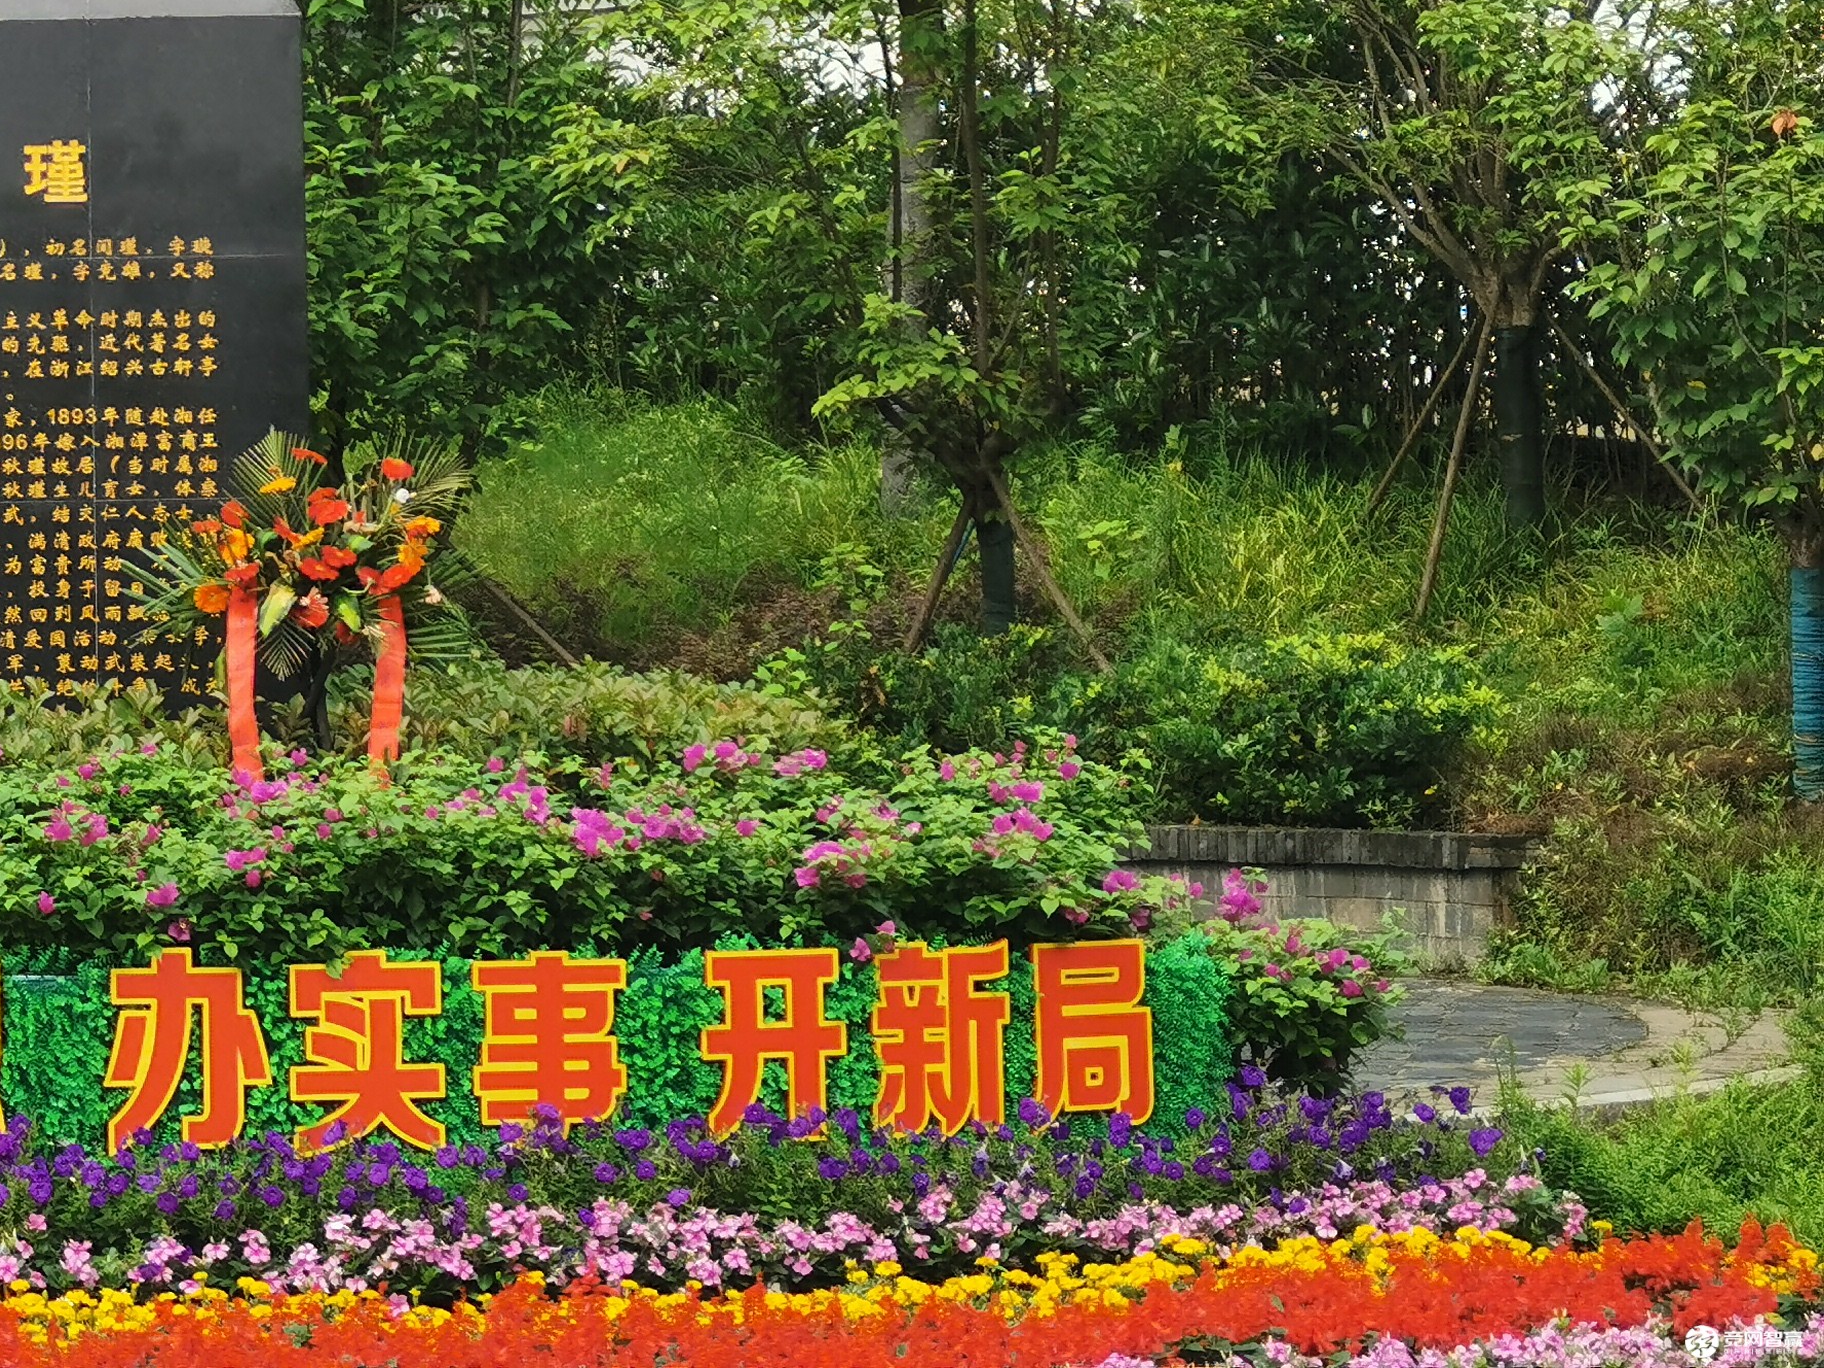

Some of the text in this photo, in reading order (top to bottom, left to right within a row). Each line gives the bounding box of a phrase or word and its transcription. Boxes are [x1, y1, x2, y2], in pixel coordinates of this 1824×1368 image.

[103, 947, 627, 1157] 办实事
[700, 937, 1154, 1142] 开新局
